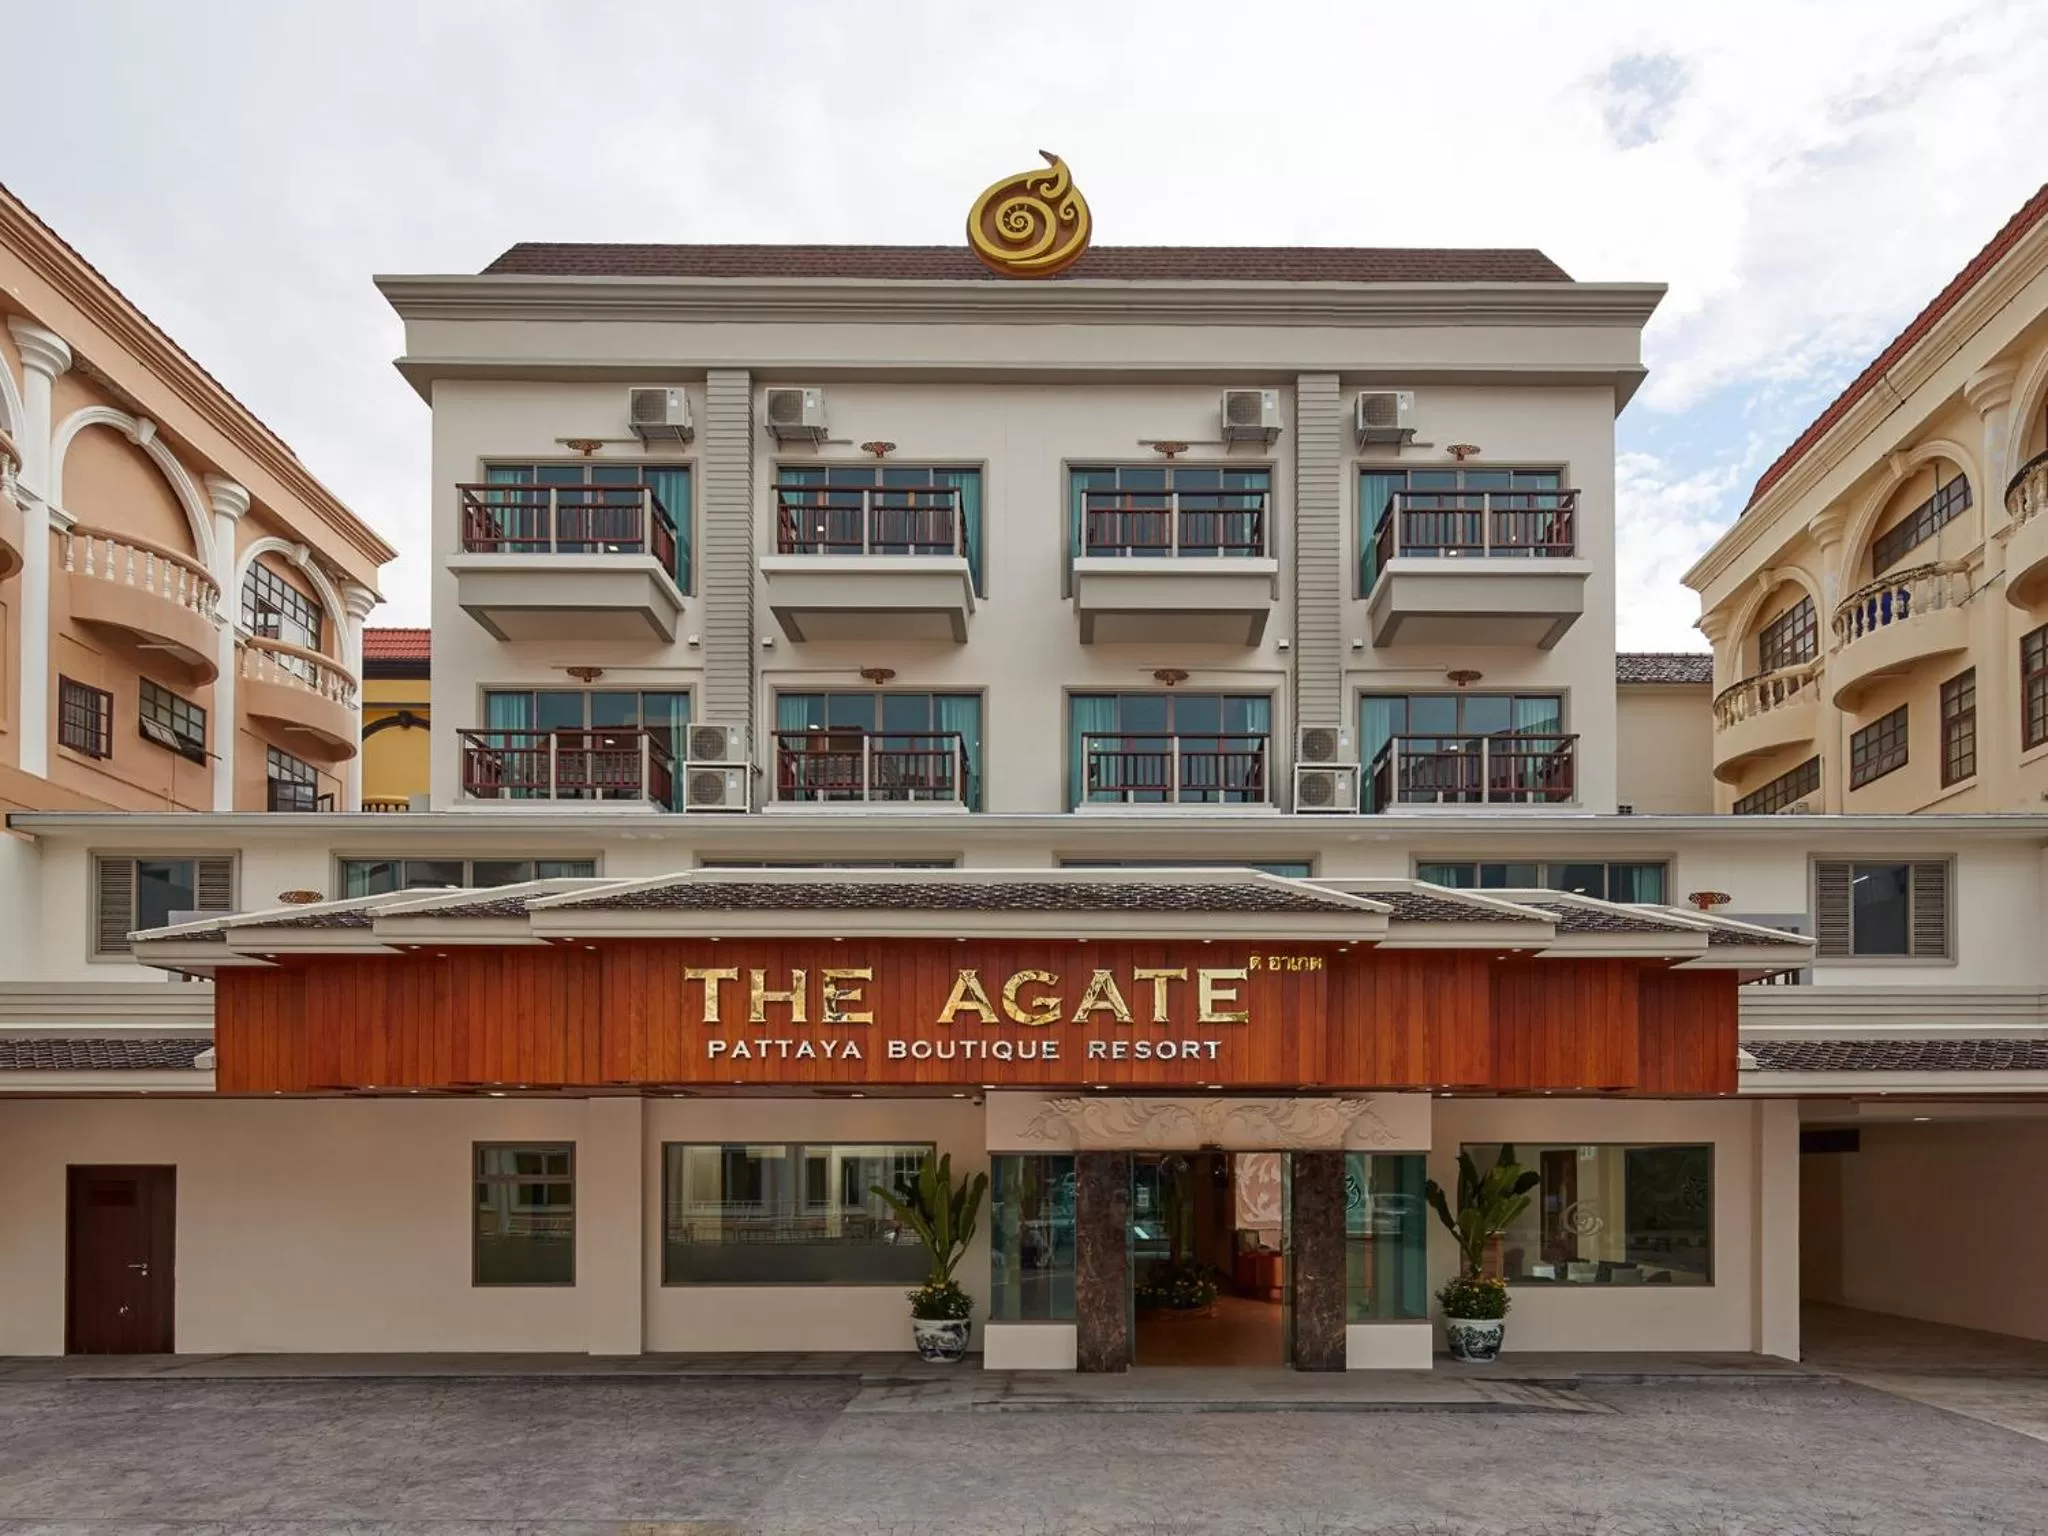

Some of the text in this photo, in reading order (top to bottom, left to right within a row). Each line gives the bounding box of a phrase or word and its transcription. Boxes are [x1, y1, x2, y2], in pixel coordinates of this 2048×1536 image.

[683, 966, 1249, 1026] THE AGATE
[707, 1039, 1223, 1061] PATTAYA BOUTIQUE RESORT
